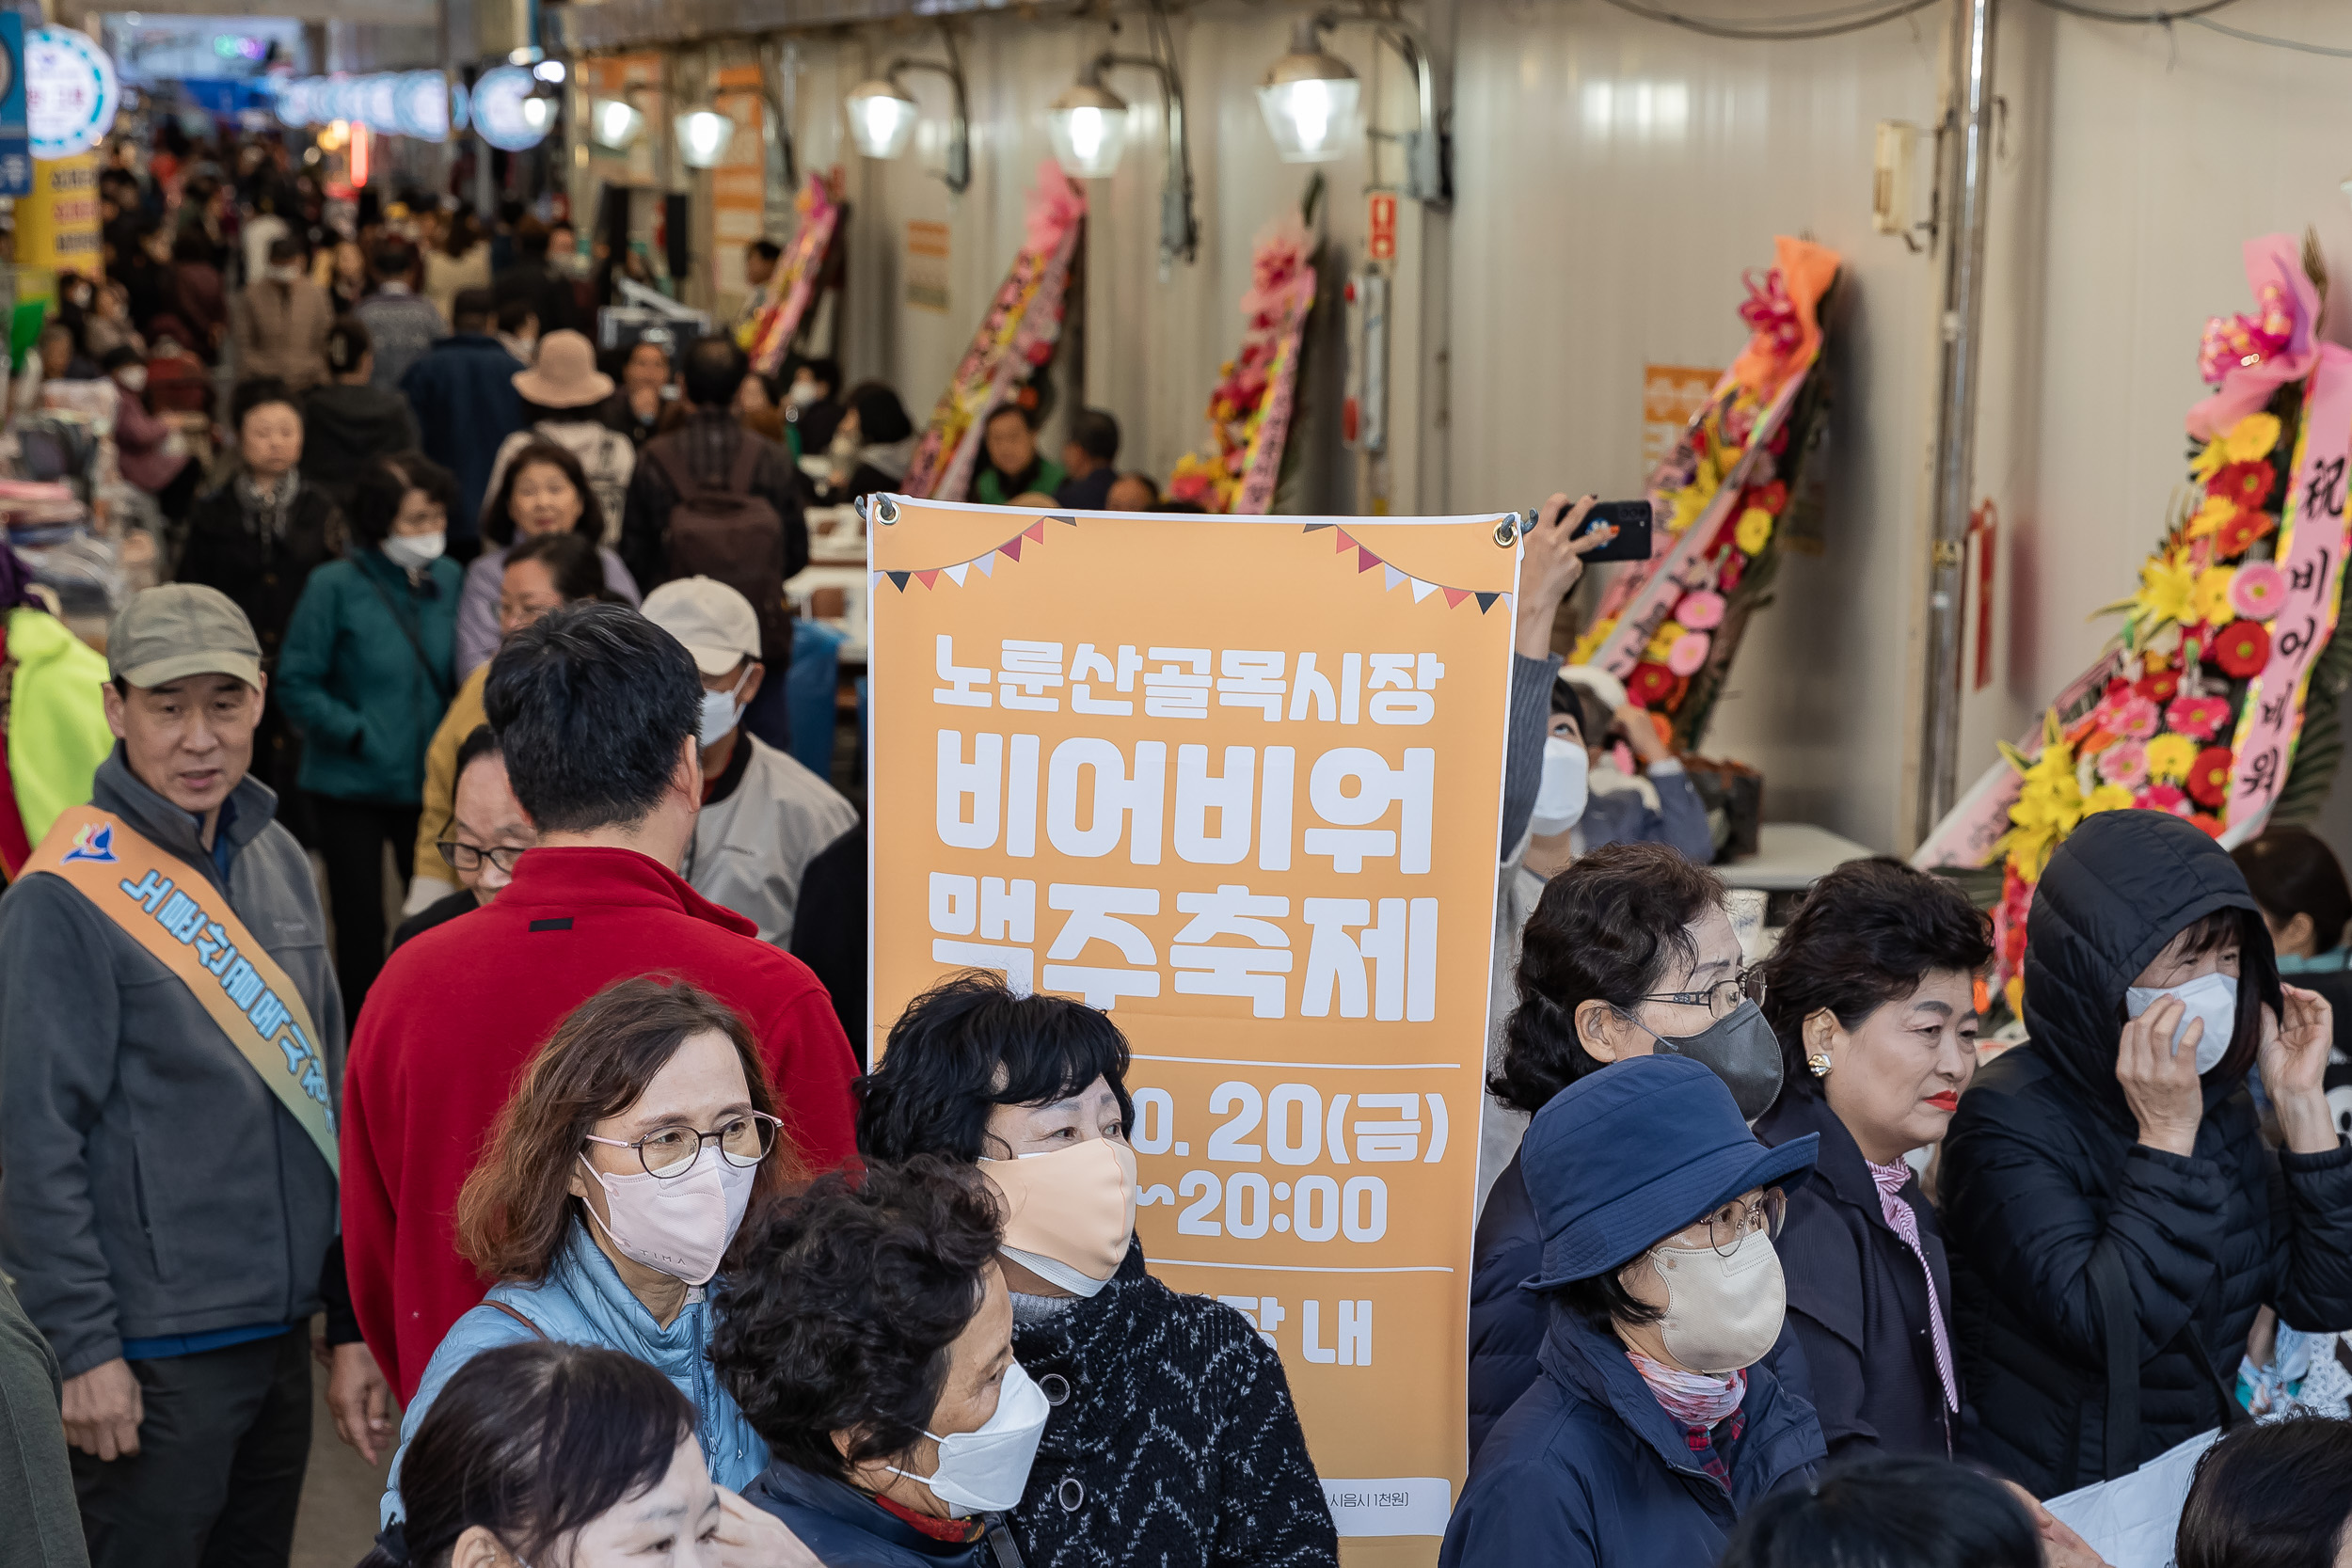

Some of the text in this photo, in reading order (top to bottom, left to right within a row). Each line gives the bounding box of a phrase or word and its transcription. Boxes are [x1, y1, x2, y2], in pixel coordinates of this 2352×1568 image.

[932, 634, 1446, 725] 노룬산골목시장
[934, 729, 1436, 874] 비어비워
[928, 871, 1438, 1022] 맥주축제
[1207, 1081, 1449, 1166] 20(금)
[1302, 1299, 1373, 1367] 내
[1329, 1493, 1370, 1508] 시음시
